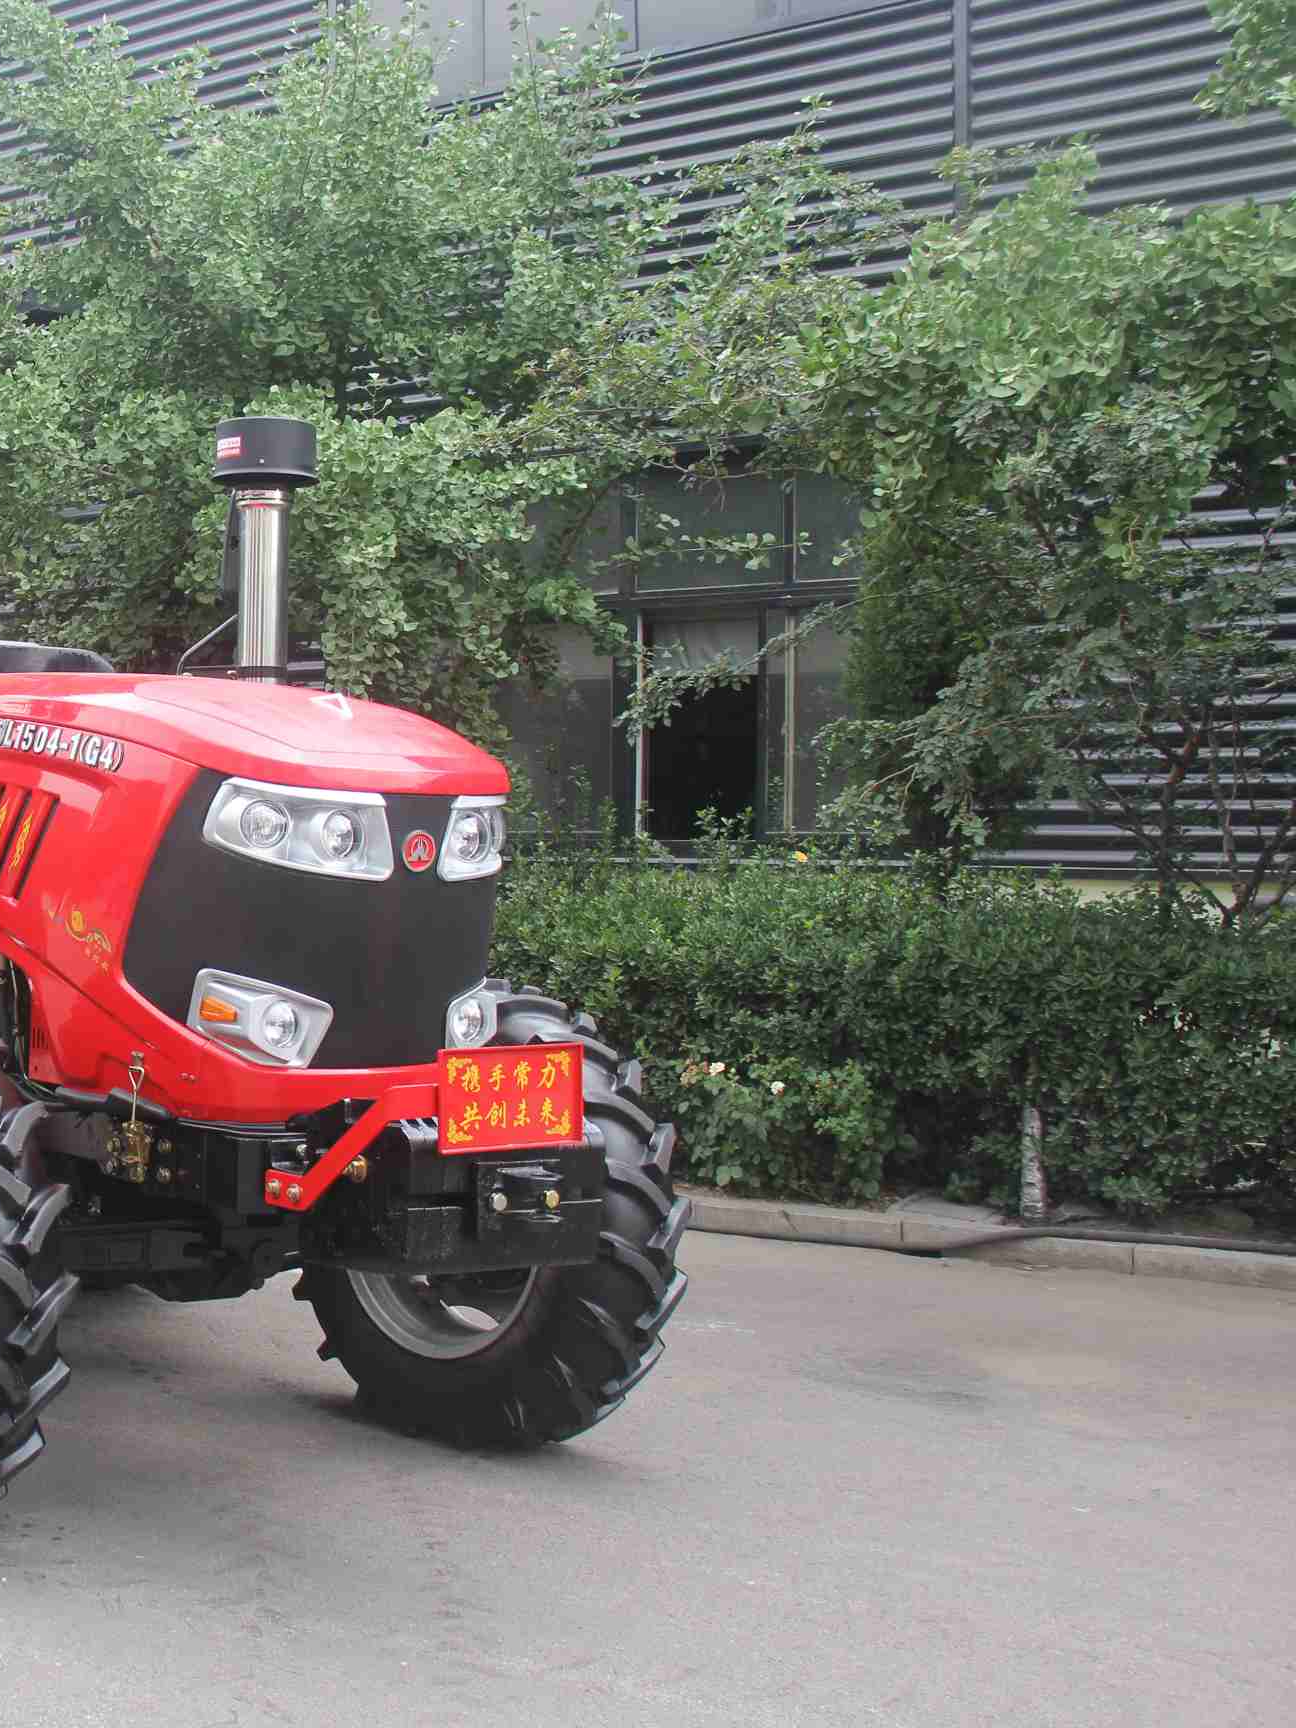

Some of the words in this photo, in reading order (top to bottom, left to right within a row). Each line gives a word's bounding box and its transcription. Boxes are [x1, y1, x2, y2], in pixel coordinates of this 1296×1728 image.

[462, 1061, 557, 1092] 携手常力
[461, 1098, 557, 1129] 共创未来
